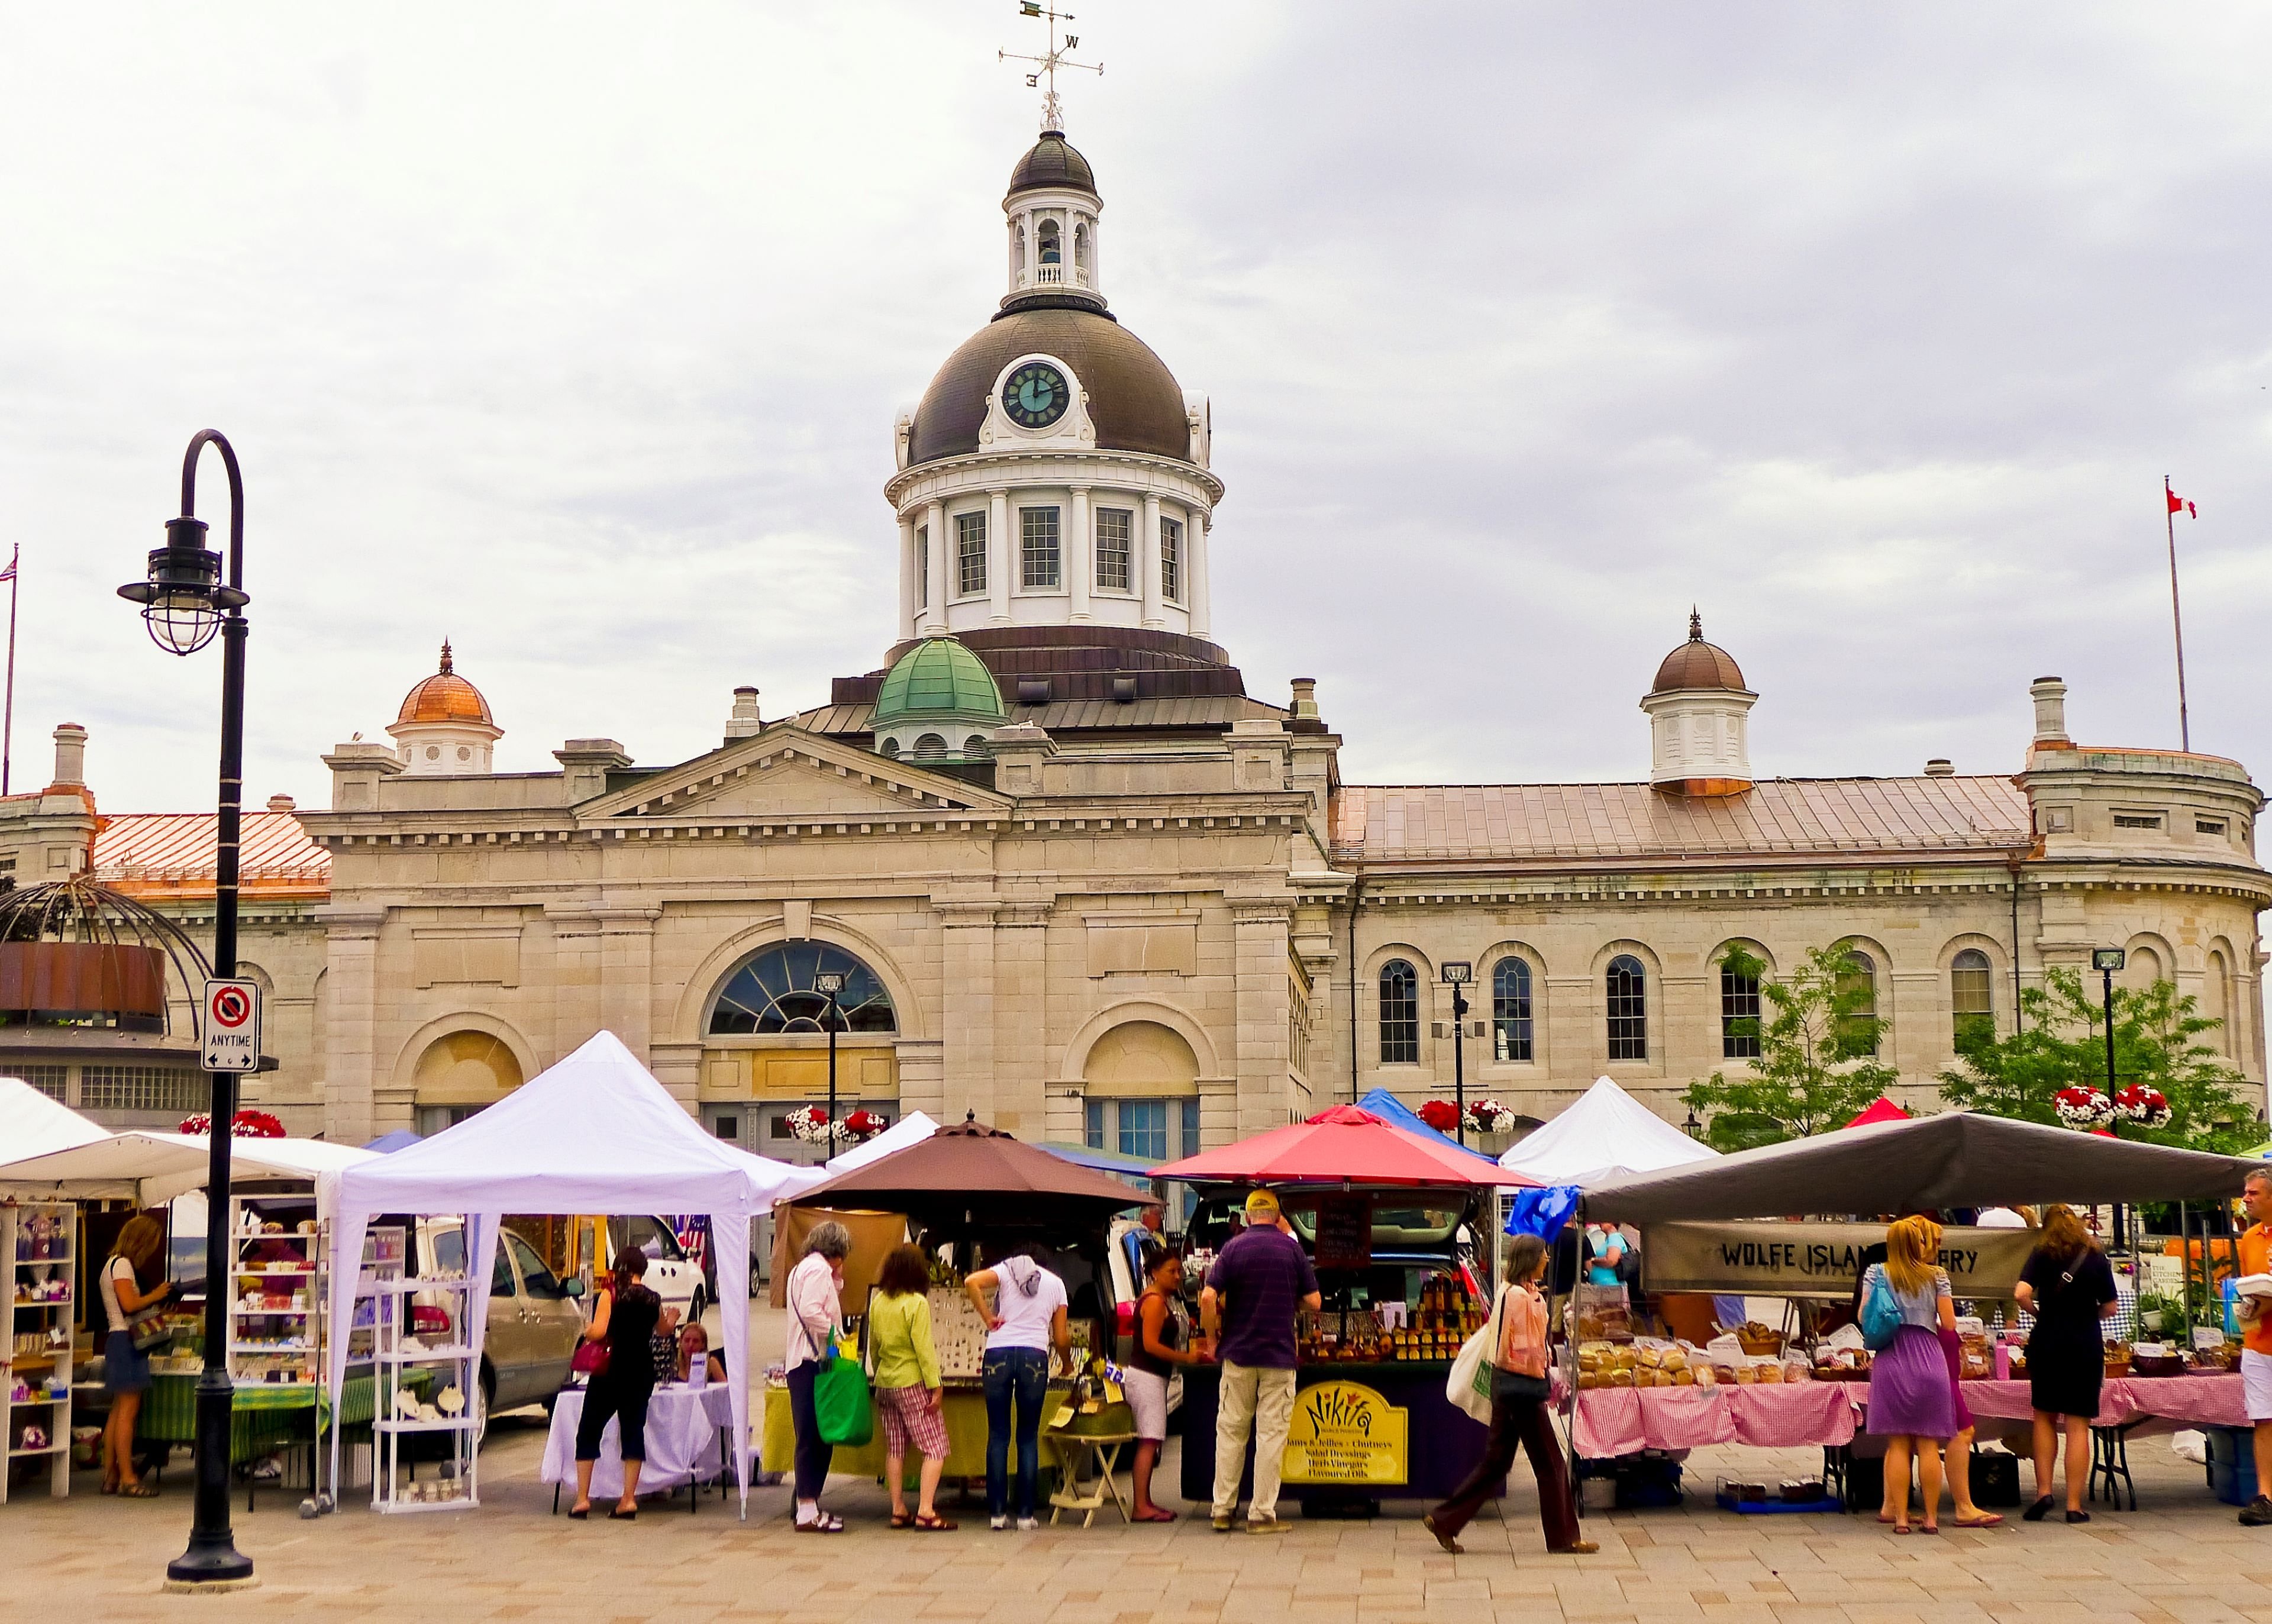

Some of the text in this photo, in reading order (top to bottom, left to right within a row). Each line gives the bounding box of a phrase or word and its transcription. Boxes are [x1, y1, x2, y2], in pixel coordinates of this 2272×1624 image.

[1066, 34, 1079, 49] W
[211, 1034, 251, 1047] ANYTIME
[1722, 1242, 1796, 1267] WOLFE
[1806, 1244, 1871, 1268] ISLAN
[1305, 1386, 1372, 1440] Nikita
[1319, 1438, 1344, 1448] Jellies
[1352, 1438, 1393, 1449] Chutneys
